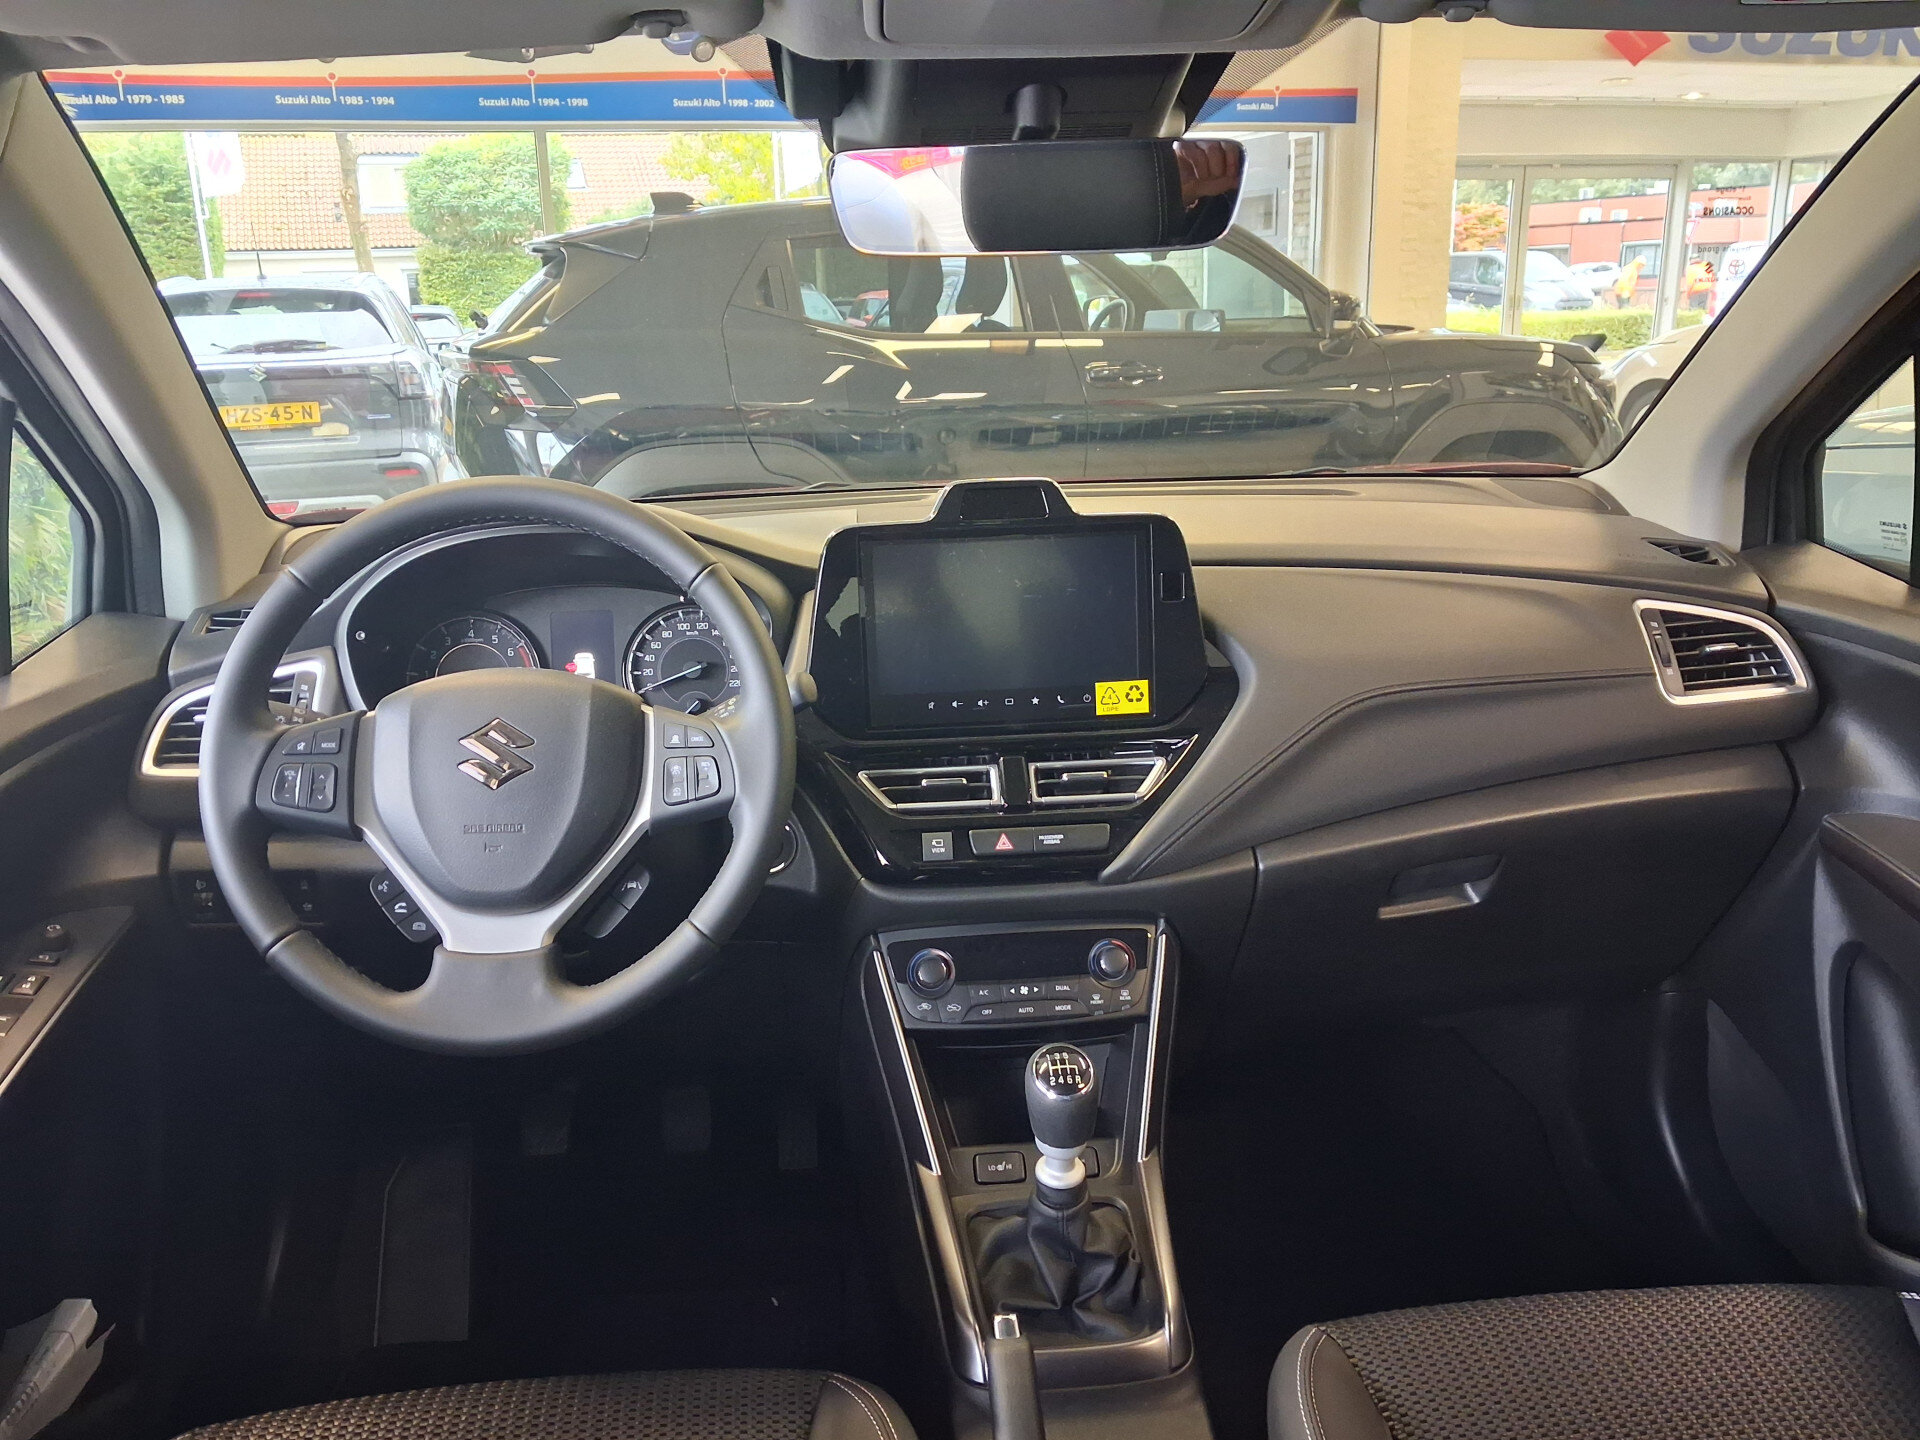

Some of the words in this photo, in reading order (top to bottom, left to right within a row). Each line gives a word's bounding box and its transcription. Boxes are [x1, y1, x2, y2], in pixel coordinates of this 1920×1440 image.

[95, 94, 118, 105] Alto
[127, 94, 153, 105] 1979
[160, 95, 185, 105] 1985
[275, 95, 309, 105] Suzuki
[310, 95, 331, 105] Alto
[340, 96, 363, 106] 1985
[371, 96, 395, 106] 1994
[478, 97, 510, 107] Suzuki
[511, 97, 530, 107] Alto
[538, 98, 560, 107] 1994
[567, 98, 589, 107] 1998
[673, 98, 702, 108] Suzuki
[703, 98, 721, 108] Alto
[728, 98, 748, 108] 1998
[754, 99, 775, 108] 2002
[226, 405, 313, 424] HZS-45-N
[696, 622, 709, 630] 120
[468, 629, 475, 638] 4
[661, 630, 673, 638] 80
[711, 629, 721, 637] 14
[445, 636, 451, 646] 3
[492, 635, 498, 644] 5
[650, 641, 661, 649] 60
[507, 648, 514, 657] 6
[643, 668, 653, 677] 20
[1018, 1006, 1035, 1014] AUTO
[1055, 1004, 1072, 1012] MODE
[1050, 1076, 1056, 1086] 2
[1058, 1075, 1065, 1085] 4
[1067, 1075, 1073, 1084] 6
[1075, 1074, 1081, 1084] R
